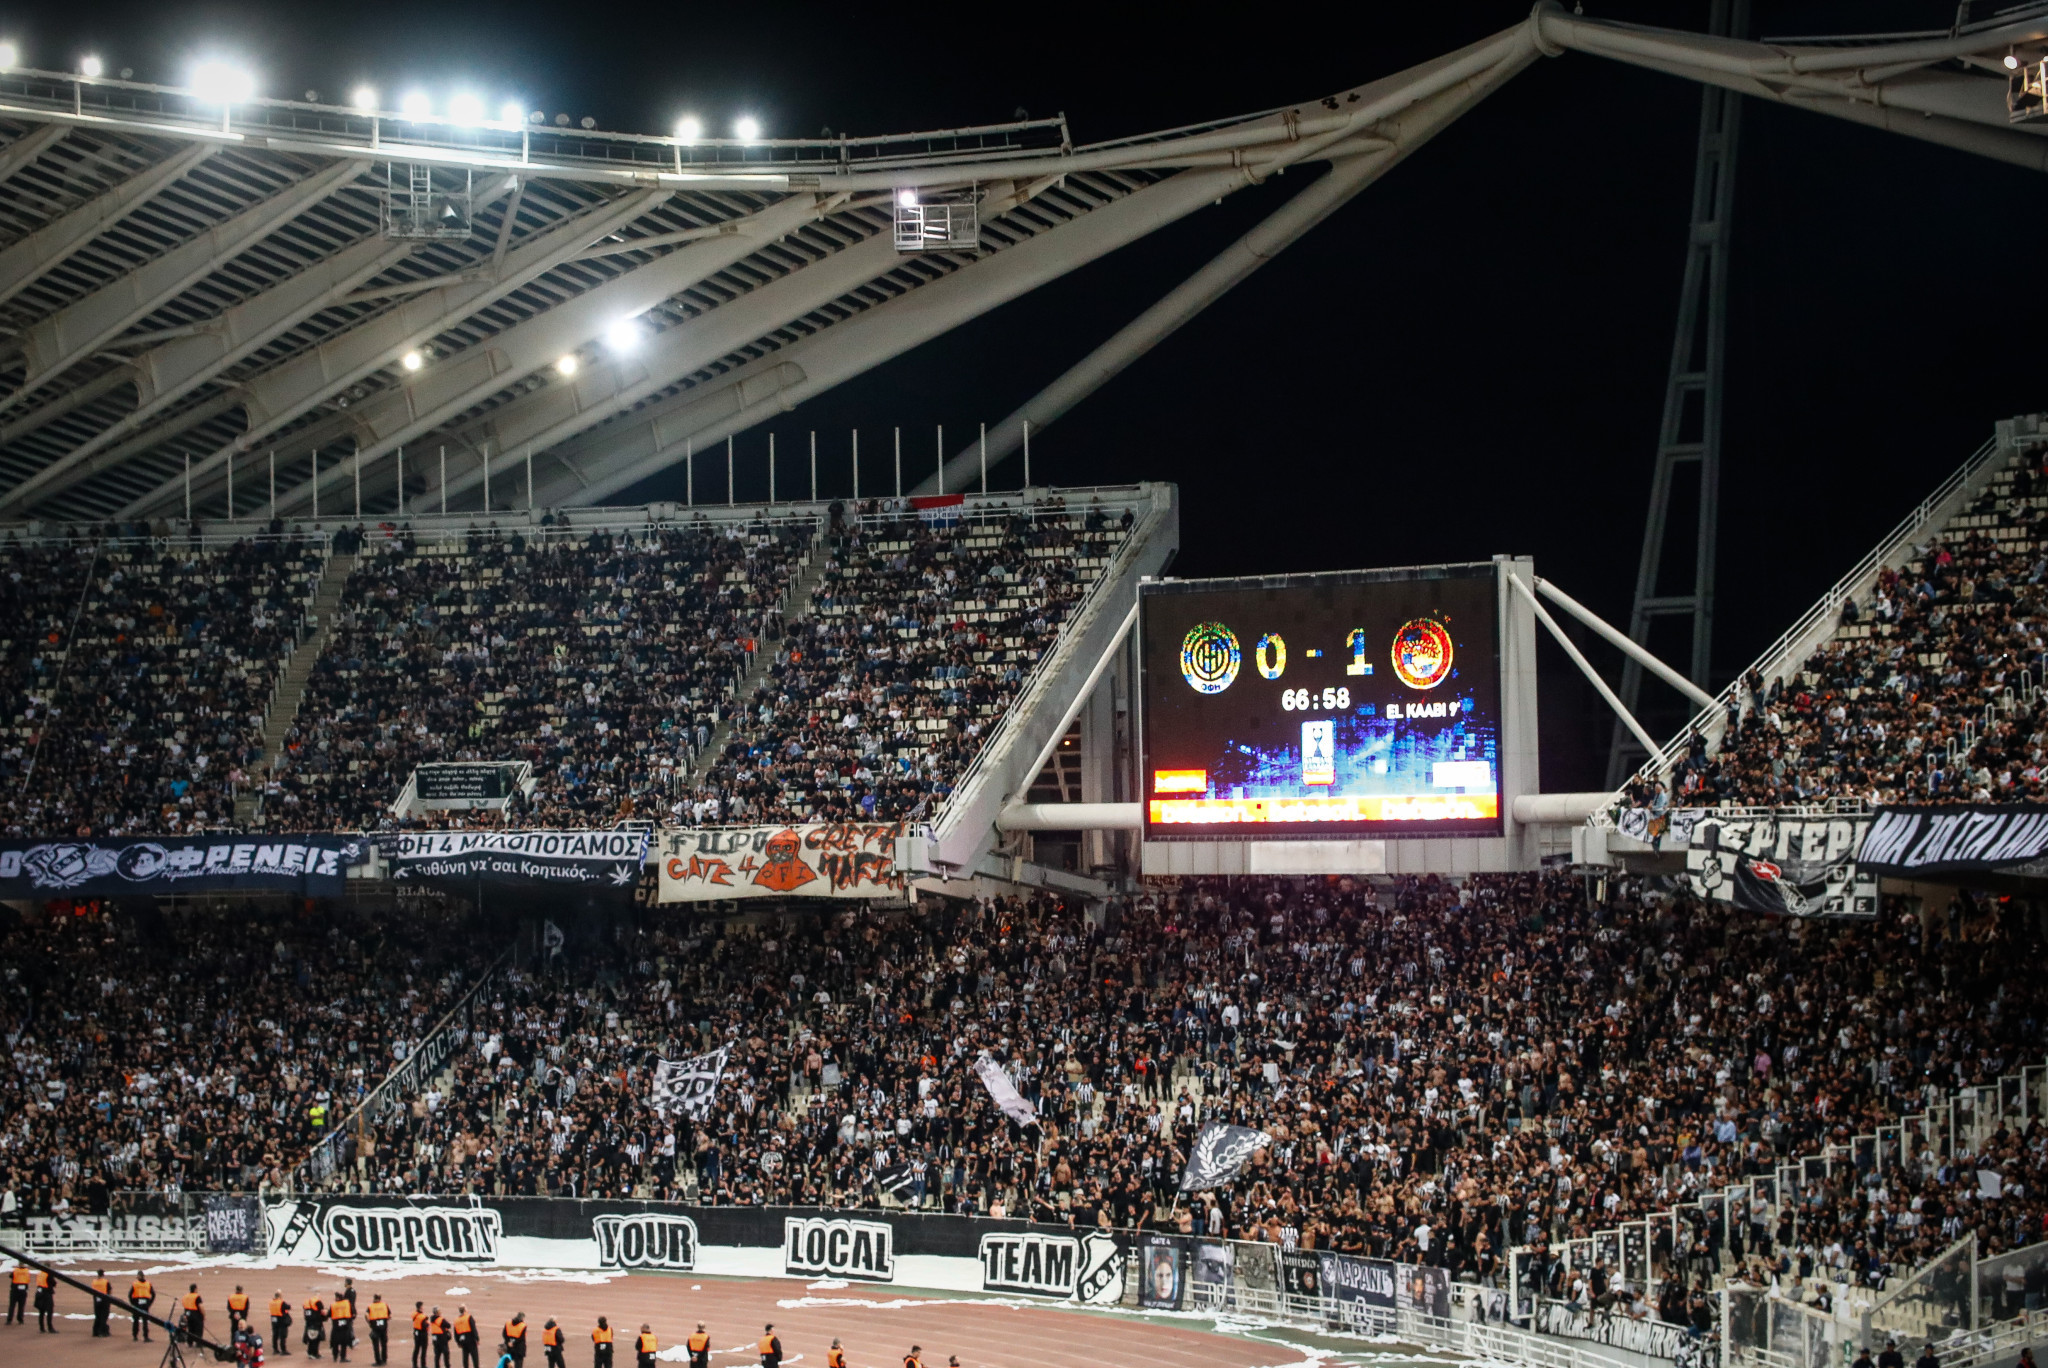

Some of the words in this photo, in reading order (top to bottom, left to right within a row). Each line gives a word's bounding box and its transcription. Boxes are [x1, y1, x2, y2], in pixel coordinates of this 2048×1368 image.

[1256, 632, 1286, 680] 0
[1346, 628, 1373, 676] 1
[1281, 687, 1351, 711] 66:58
[1386, 704, 1404, 719] EL
[1406, 702, 1446, 718] KAABI
[439, 836, 452, 852] 4
[667, 854, 736, 887] GATE
[738, 853, 759, 880] 4
[333, 1212, 497, 1258] SUPPORT
[599, 1220, 693, 1268] YOUR
[791, 1226, 892, 1274] LOCAL
[986, 1241, 1074, 1294] TEAM
